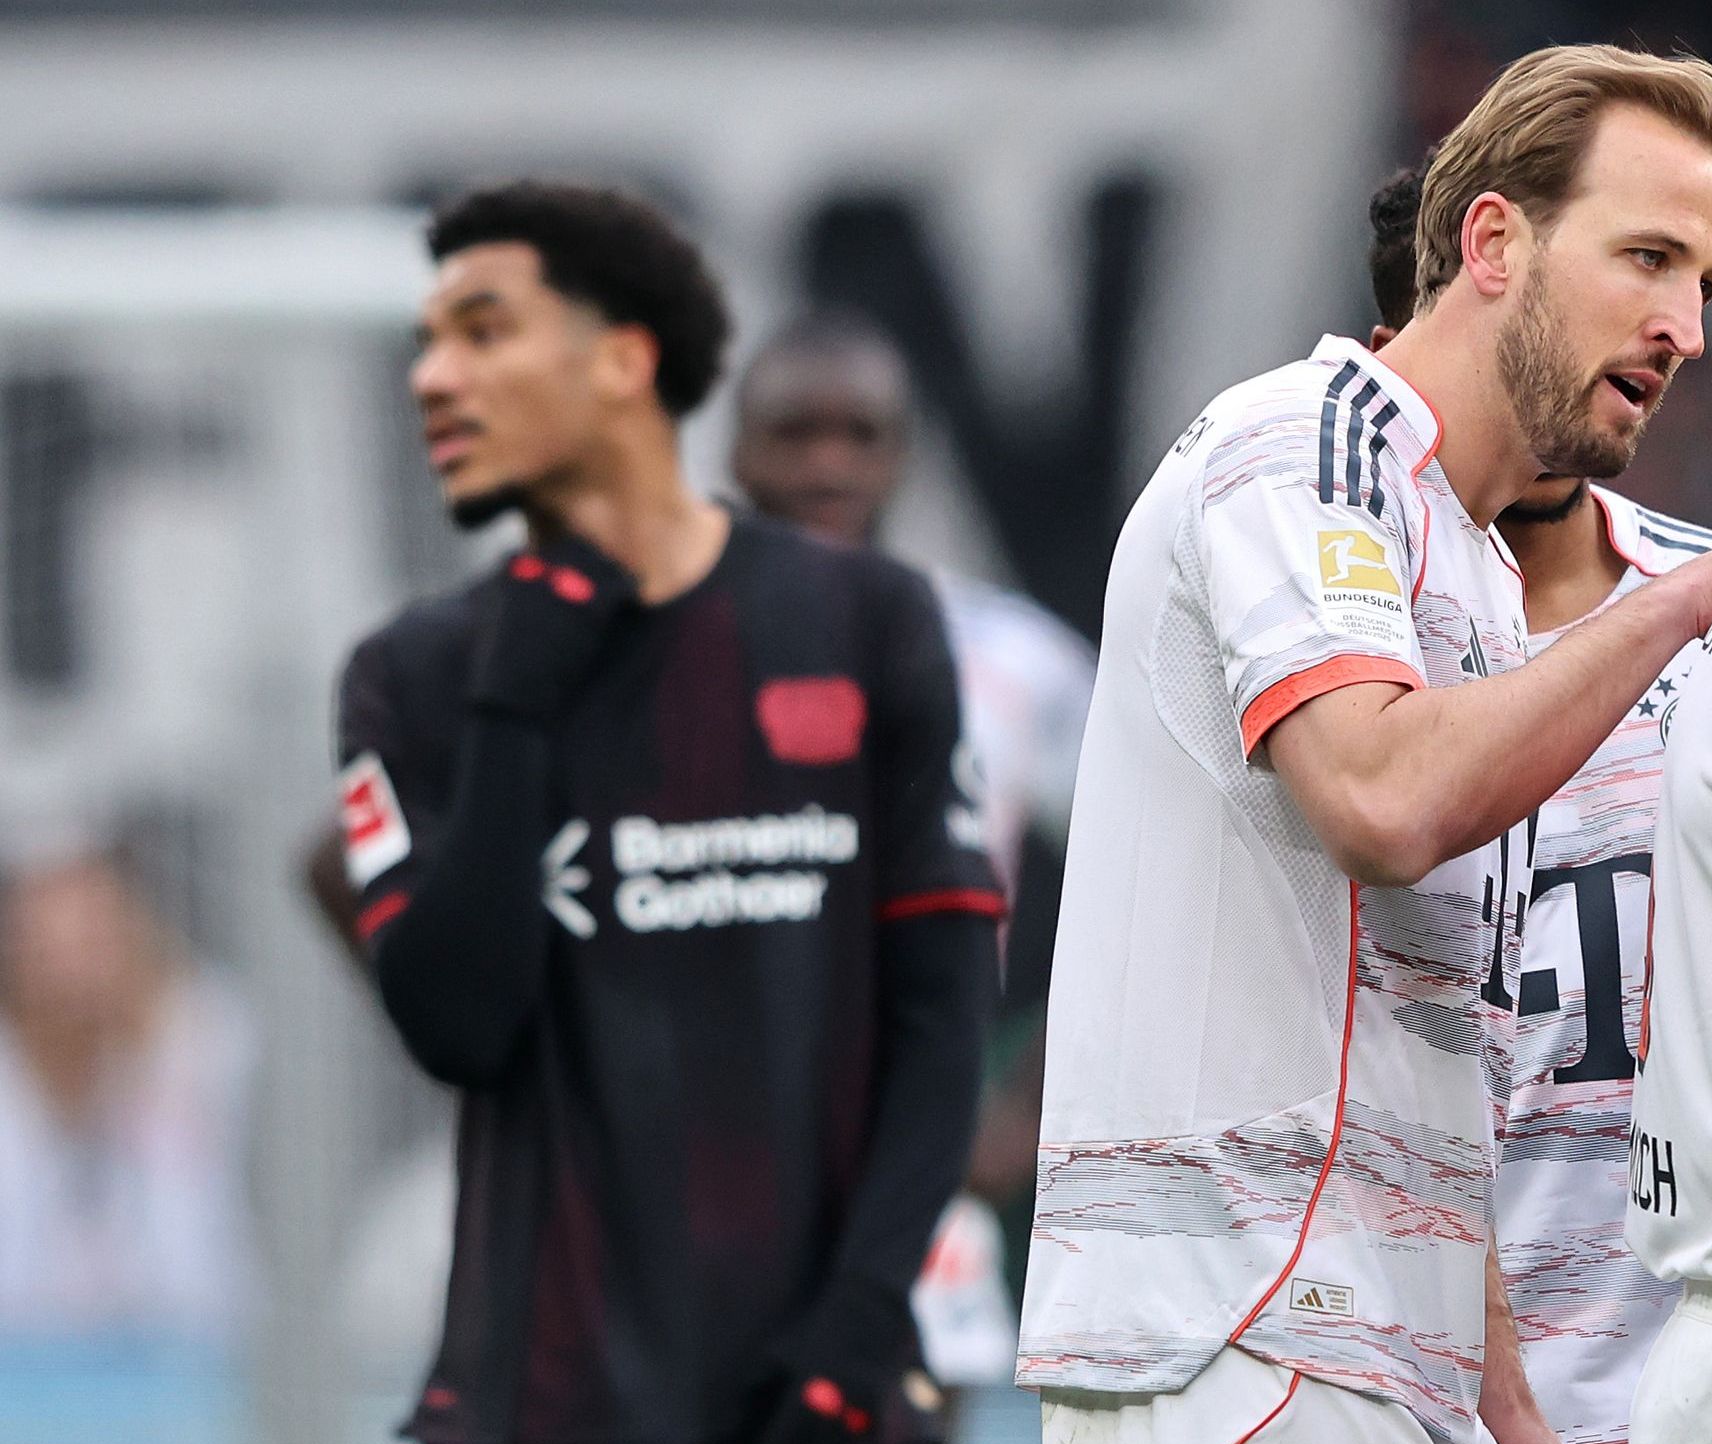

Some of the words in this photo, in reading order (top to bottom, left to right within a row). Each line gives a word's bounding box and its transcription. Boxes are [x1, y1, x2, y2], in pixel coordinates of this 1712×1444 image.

[1323, 594, 1402, 613] BUNDESLIGA
[611, 803, 858, 873] Barmenia
[613, 871, 828, 934] Gothaer
